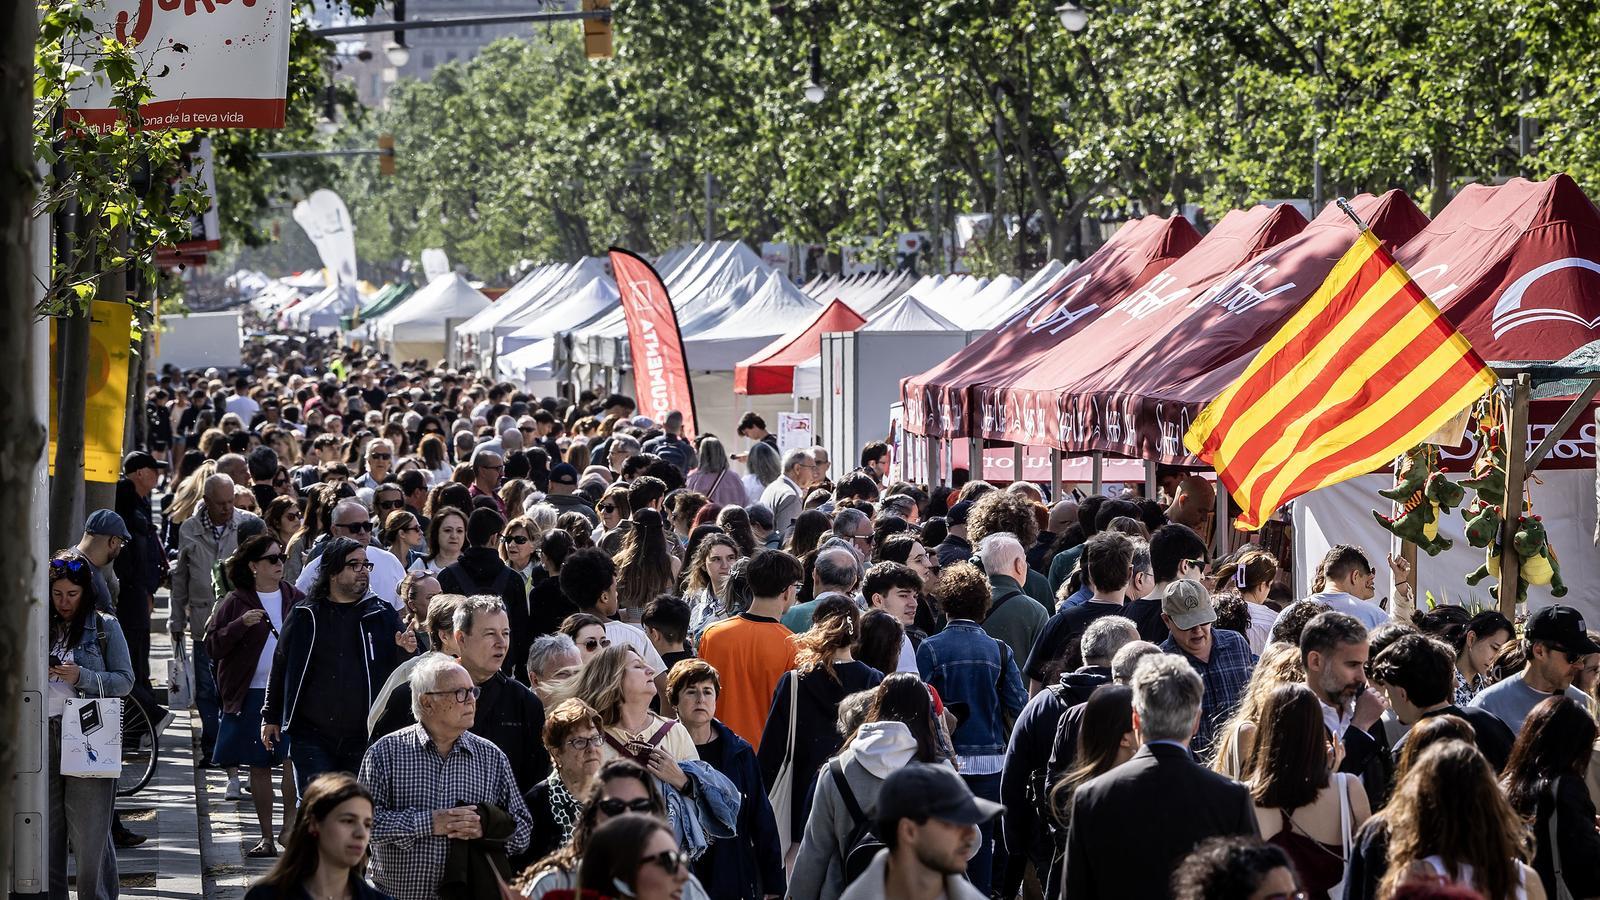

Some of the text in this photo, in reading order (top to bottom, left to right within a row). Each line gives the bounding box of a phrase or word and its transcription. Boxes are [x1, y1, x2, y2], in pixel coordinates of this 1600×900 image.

[103, 122, 112, 133] la
[165, 113, 180, 124] de
[181, 112, 191, 123] la
[193, 113, 218, 123] teva
[220, 111, 244, 122] vida
